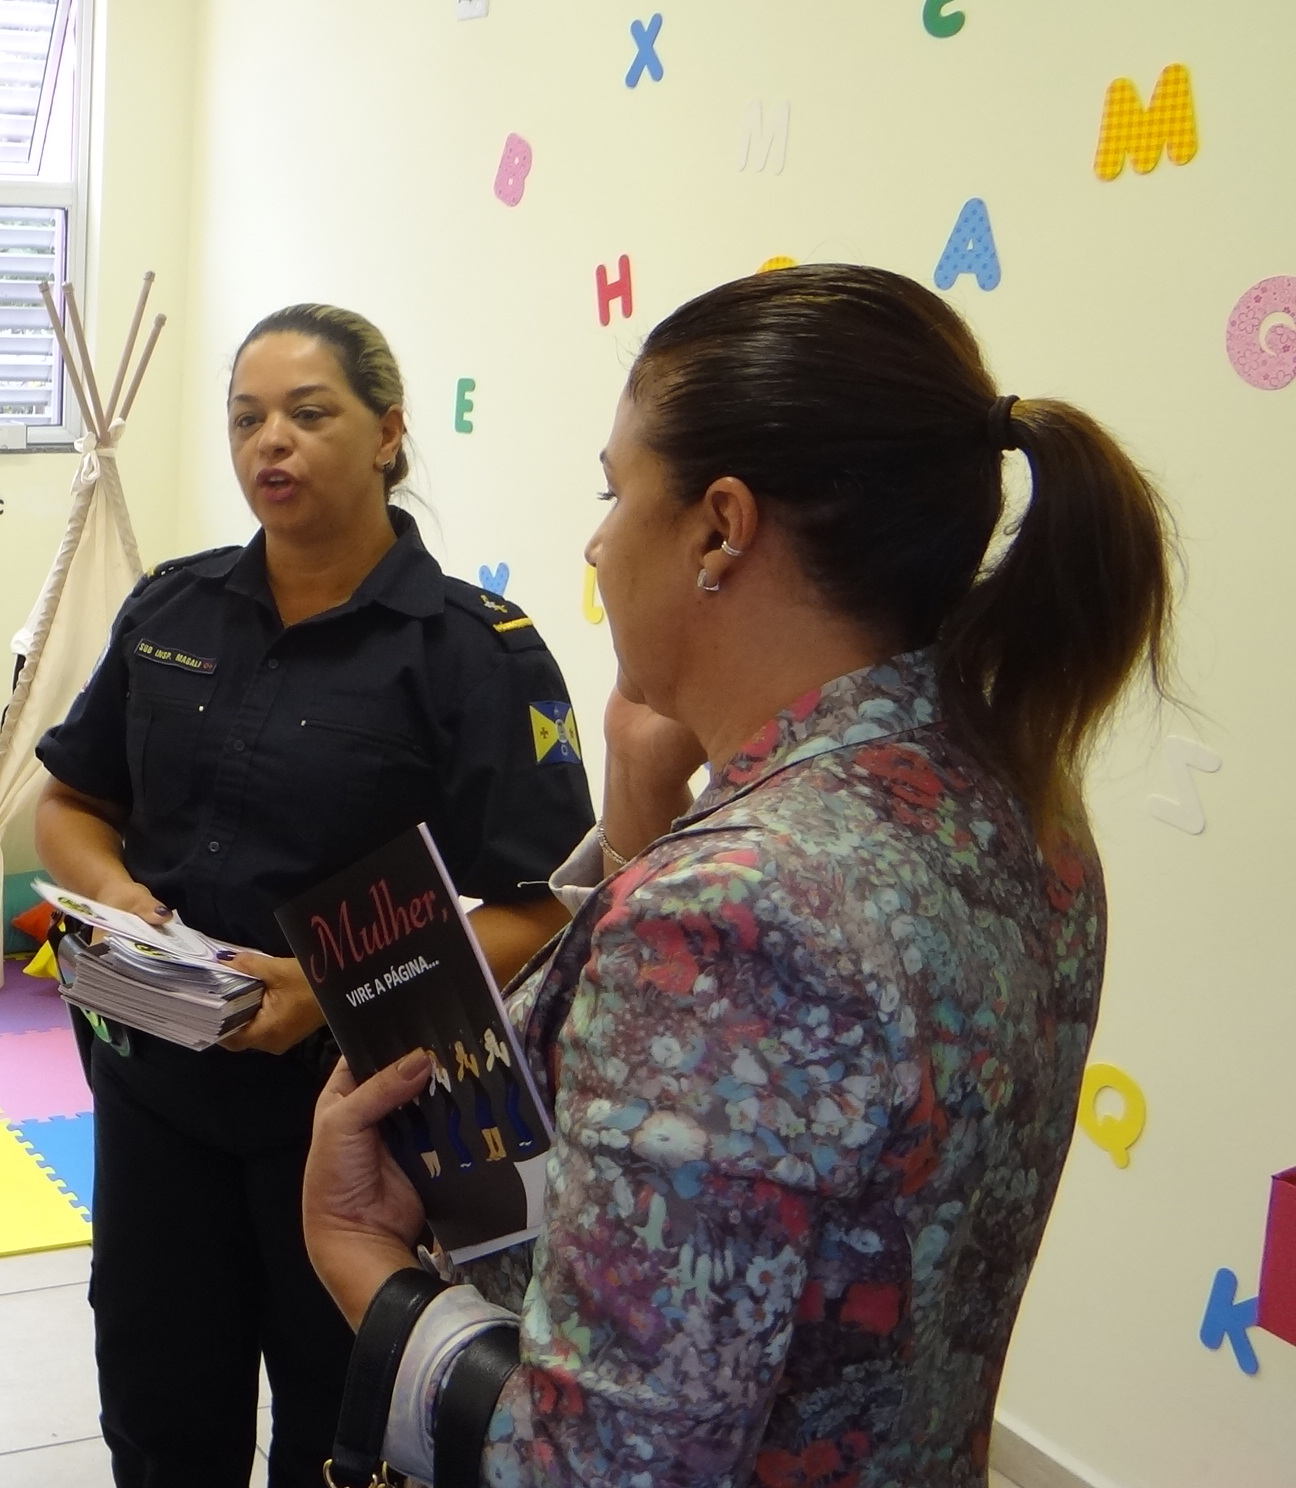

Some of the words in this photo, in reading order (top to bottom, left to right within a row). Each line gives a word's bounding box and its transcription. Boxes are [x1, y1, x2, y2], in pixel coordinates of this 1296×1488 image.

[625, 13, 664, 88] X
[736, 98, 791, 176] M
[1094, 62, 1198, 182] M
[493, 132, 532, 207] B
[934, 197, 1001, 291] A
[596, 254, 632, 327] H
[455, 378, 476, 434] E
[310, 878, 448, 983] Mulher,
[345, 983, 376, 1008] VIRE
[374, 978, 386, 995] A
[383, 955, 440, 990] PÁGINA...
[1077, 1063, 1147, 1169] Q
[1200, 1267, 1259, 1375] K
